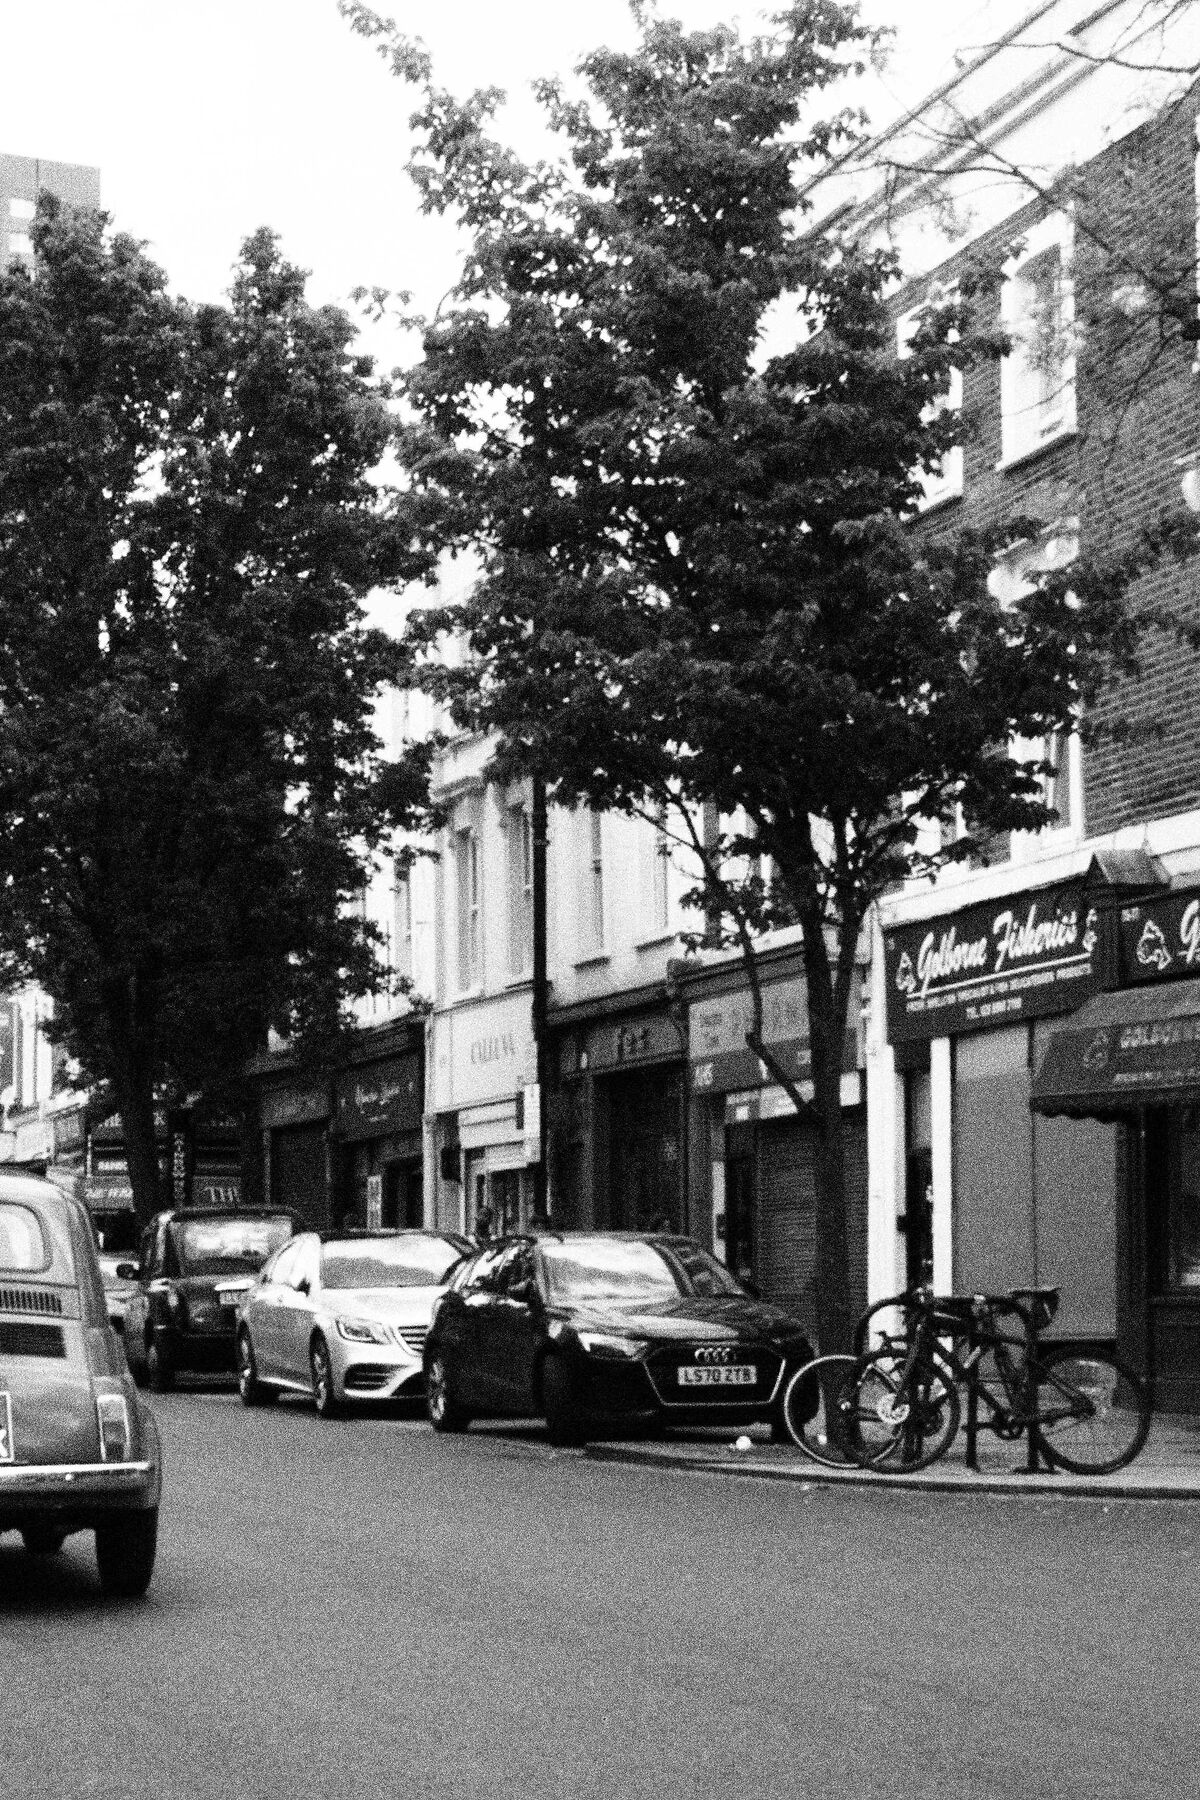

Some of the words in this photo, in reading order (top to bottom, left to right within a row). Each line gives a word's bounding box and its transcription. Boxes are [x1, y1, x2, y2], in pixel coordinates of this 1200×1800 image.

[916, 926, 988, 999] Golborne
[992, 903, 1078, 973] Fisheries
[684, 1368, 721, 1383] LS70
